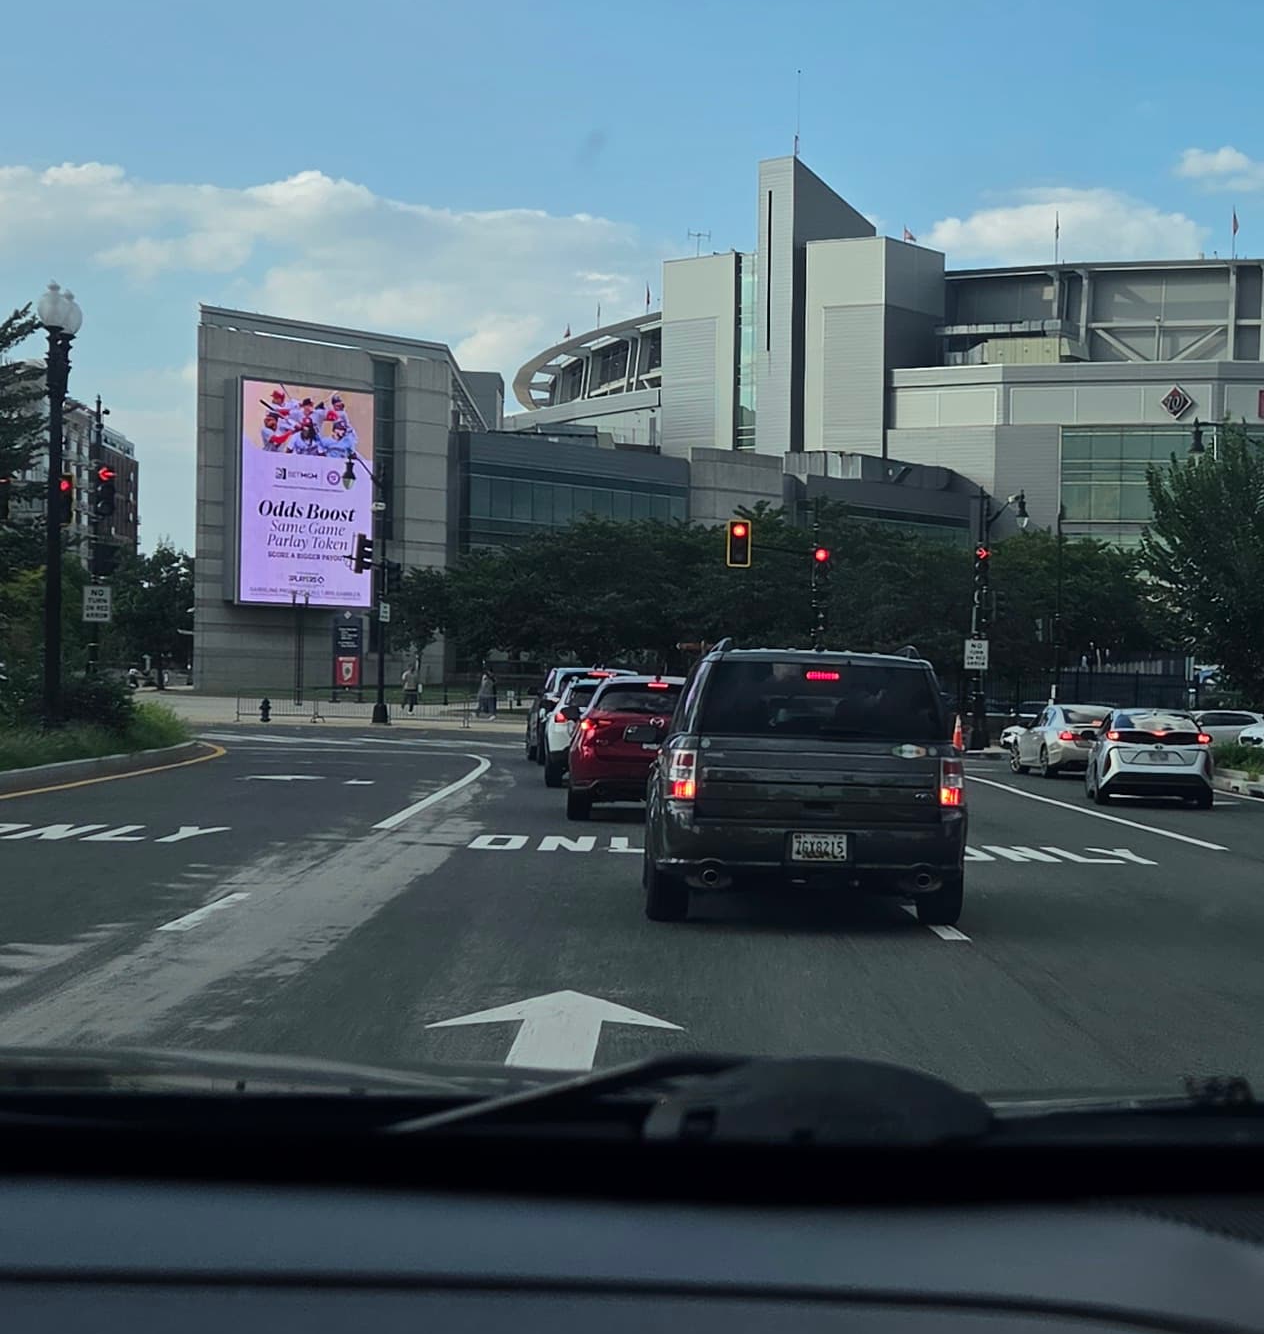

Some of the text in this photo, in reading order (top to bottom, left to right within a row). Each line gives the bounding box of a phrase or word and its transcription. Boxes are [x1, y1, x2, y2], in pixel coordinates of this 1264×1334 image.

[258, 499, 356, 522] Odds Boost
[270, 520, 346, 537] Same Game
[267, 533, 348, 551] Parlay Token
[467, 834, 645, 854] ONL
